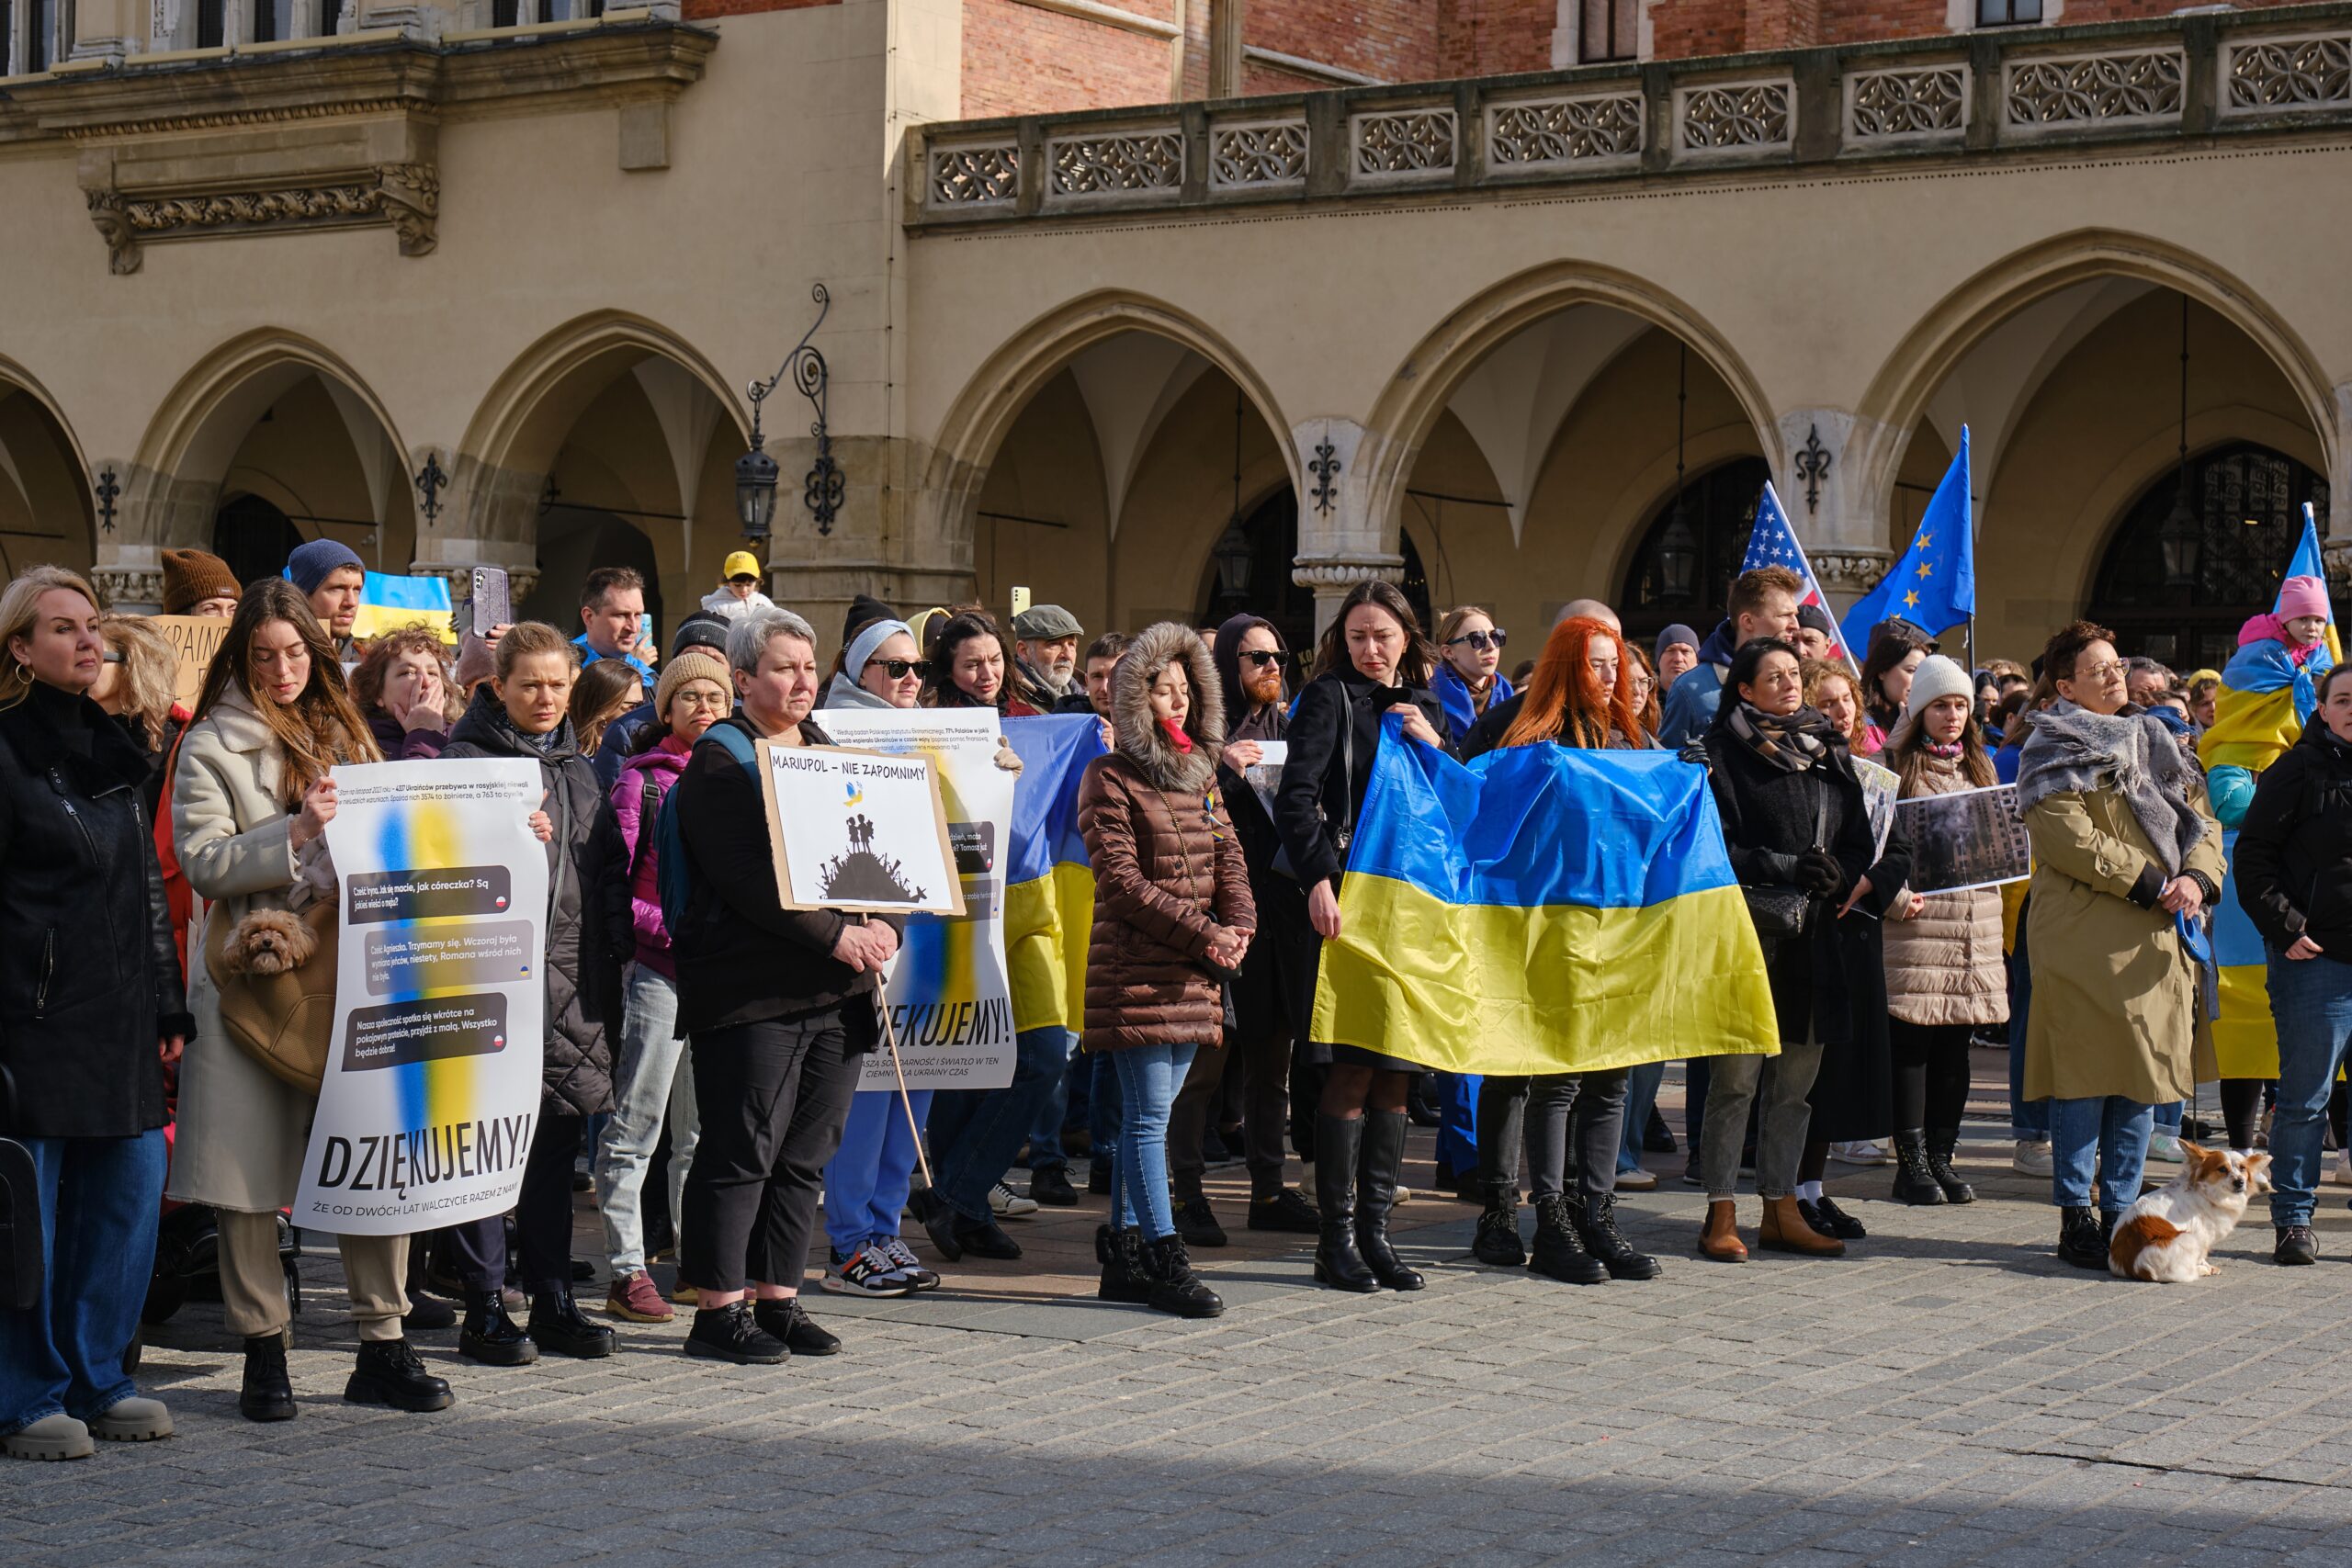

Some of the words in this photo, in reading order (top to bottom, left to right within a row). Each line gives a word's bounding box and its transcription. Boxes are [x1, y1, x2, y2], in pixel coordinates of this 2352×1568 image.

[773, 755, 828, 773] MARIUPOL
[842, 761, 859, 775] NIE
[862, 764, 925, 781] ZAPOMNIMY
[406, 784, 434, 792] Ukraińców
[435, 783, 467, 792] przebywa
[476, 781, 506, 791] rosyjskiej
[444, 791, 475, 800] żołnierze,
[394, 884, 415, 894] macie,
[416, 881, 429, 894] jak
[431, 879, 474, 891] córeczka?
[476, 878, 489, 889] Są
[408, 940, 446, 953] Trzymamy
[447, 938, 461, 949] się.
[463, 936, 498, 947] Wczoraj
[499, 933, 517, 945] była
[410, 953, 438, 964] niestety,
[440, 950, 476, 961] Romana
[477, 947, 503, 957] wśród
[504, 945, 522, 956] nich
[356, 1020, 375, 1031] Nasza
[375, 1015, 401, 1030] społeczność
[402, 1013, 422, 1026] spotka
[422, 1011, 432, 1022] się
[433, 1009, 462, 1020] wkrótce
[464, 1008, 475, 1017] na
[877, 997, 1010, 1056] IĘKUJEMY!
[356, 1032, 388, 1046] pokojowym
[410, 1024, 433, 1037] przyjdź
[438, 1021, 460, 1032] małą.
[461, 1017, 498, 1030] Wszystko
[355, 1045, 378, 1058] będzie
[862, 1059, 879, 1068] ASZĄ
[881, 1057, 935, 1067] SOLDARNOŚĆ
[940, 1056, 975, 1066] ŚWIATŁO
[976, 1057, 984, 1066] W
[985, 1057, 1000, 1066] TEN
[865, 1069, 896, 1078] CIEMNY
[913, 1067, 947, 1077] UKRAINY
[949, 1067, 969, 1077] CZAS
[317, 1113, 531, 1201] DZIĘKUJEMY!
[312, 1200, 329, 1213] ŻE
[332, 1205, 353, 1215] OD
[356, 1203, 401, 1217] DWÓCH
[402, 1203, 420, 1214] LAT
[421, 1195, 468, 1212] WALCZYCIE
[469, 1189, 496, 1203] RAZEM
[496, 1187, 502, 1196] Z
